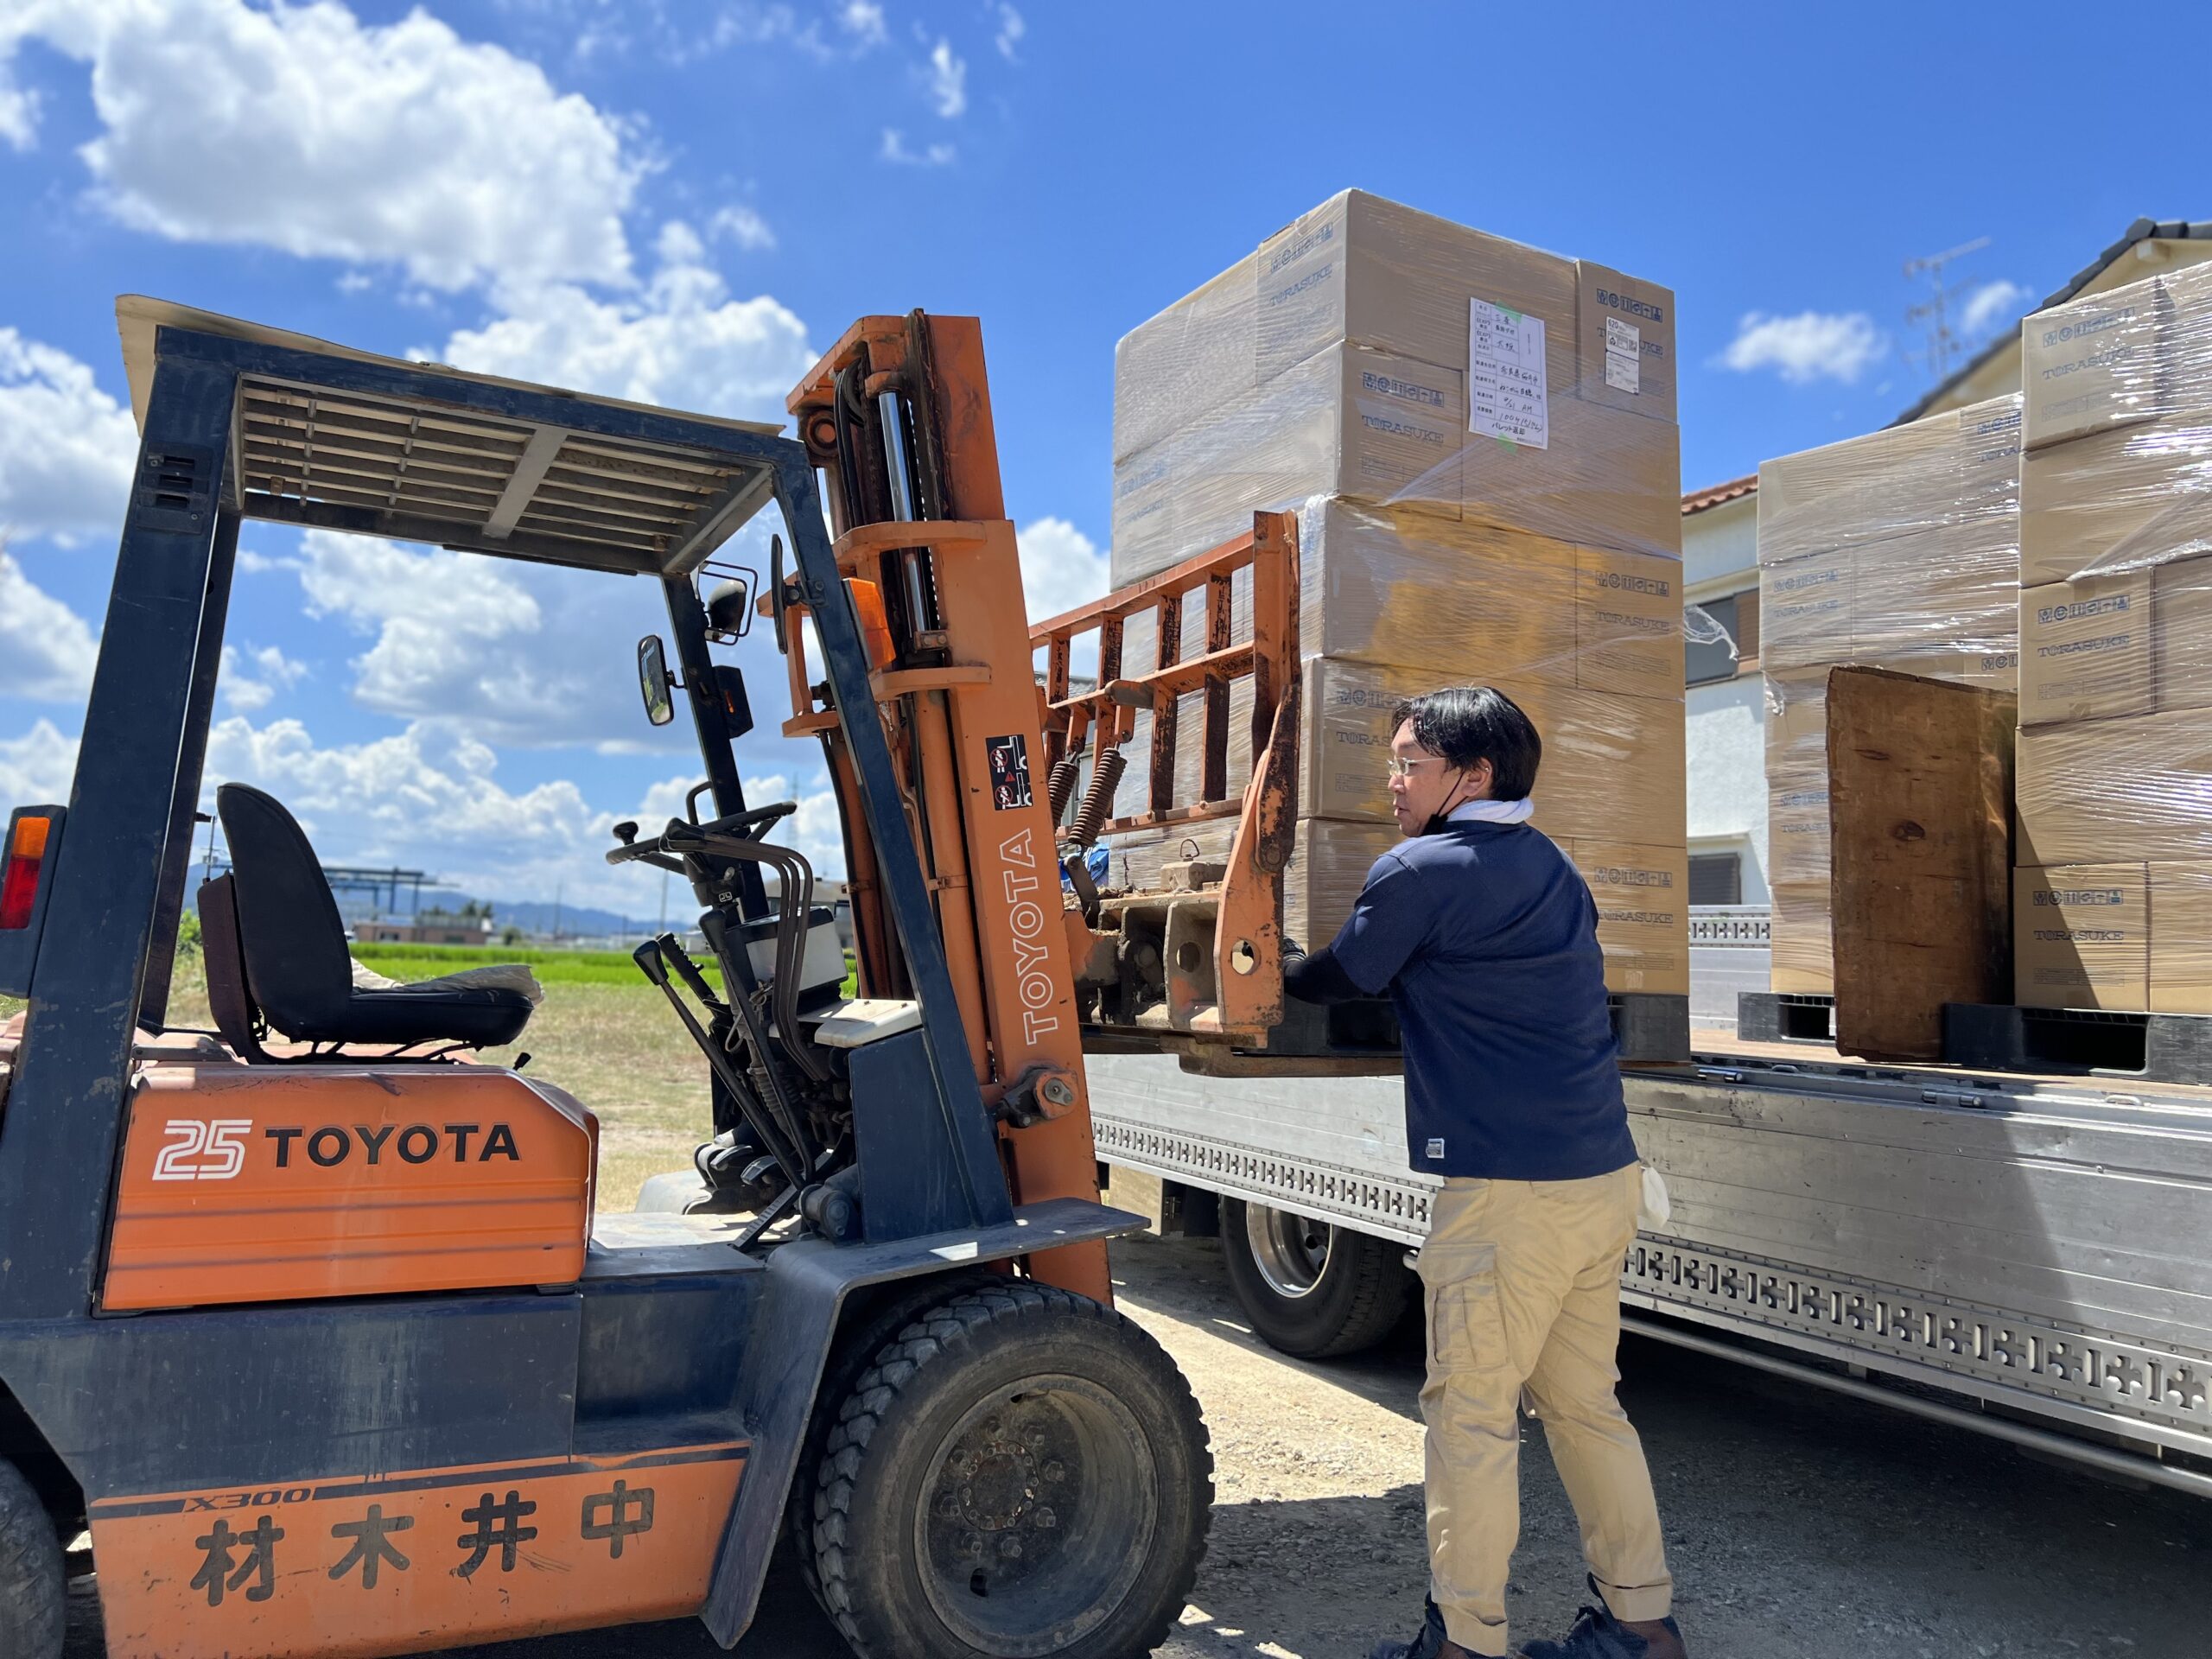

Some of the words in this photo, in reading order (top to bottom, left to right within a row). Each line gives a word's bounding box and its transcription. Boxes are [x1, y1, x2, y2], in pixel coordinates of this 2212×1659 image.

[1270, 263, 1332, 306] TORASUKE
[1596, 327, 1663, 355] TUKE
[2043, 346, 2134, 380] TORASUKE
[1362, 415, 1444, 443] TORASUKE
[1977, 446, 2021, 462] TORA
[1595, 611, 1670, 632] TORASUKE
[2037, 635, 2130, 658] TORASUKE
[1336, 731, 1392, 747] TORAS
[999, 828, 1058, 1046] TOYOTA
[2033, 930, 2124, 941] TORASUKE
[152, 1119, 253, 1181] 25
[264, 1124, 520, 1168] TOYOTA
[186, 1487, 314, 1514] X300
